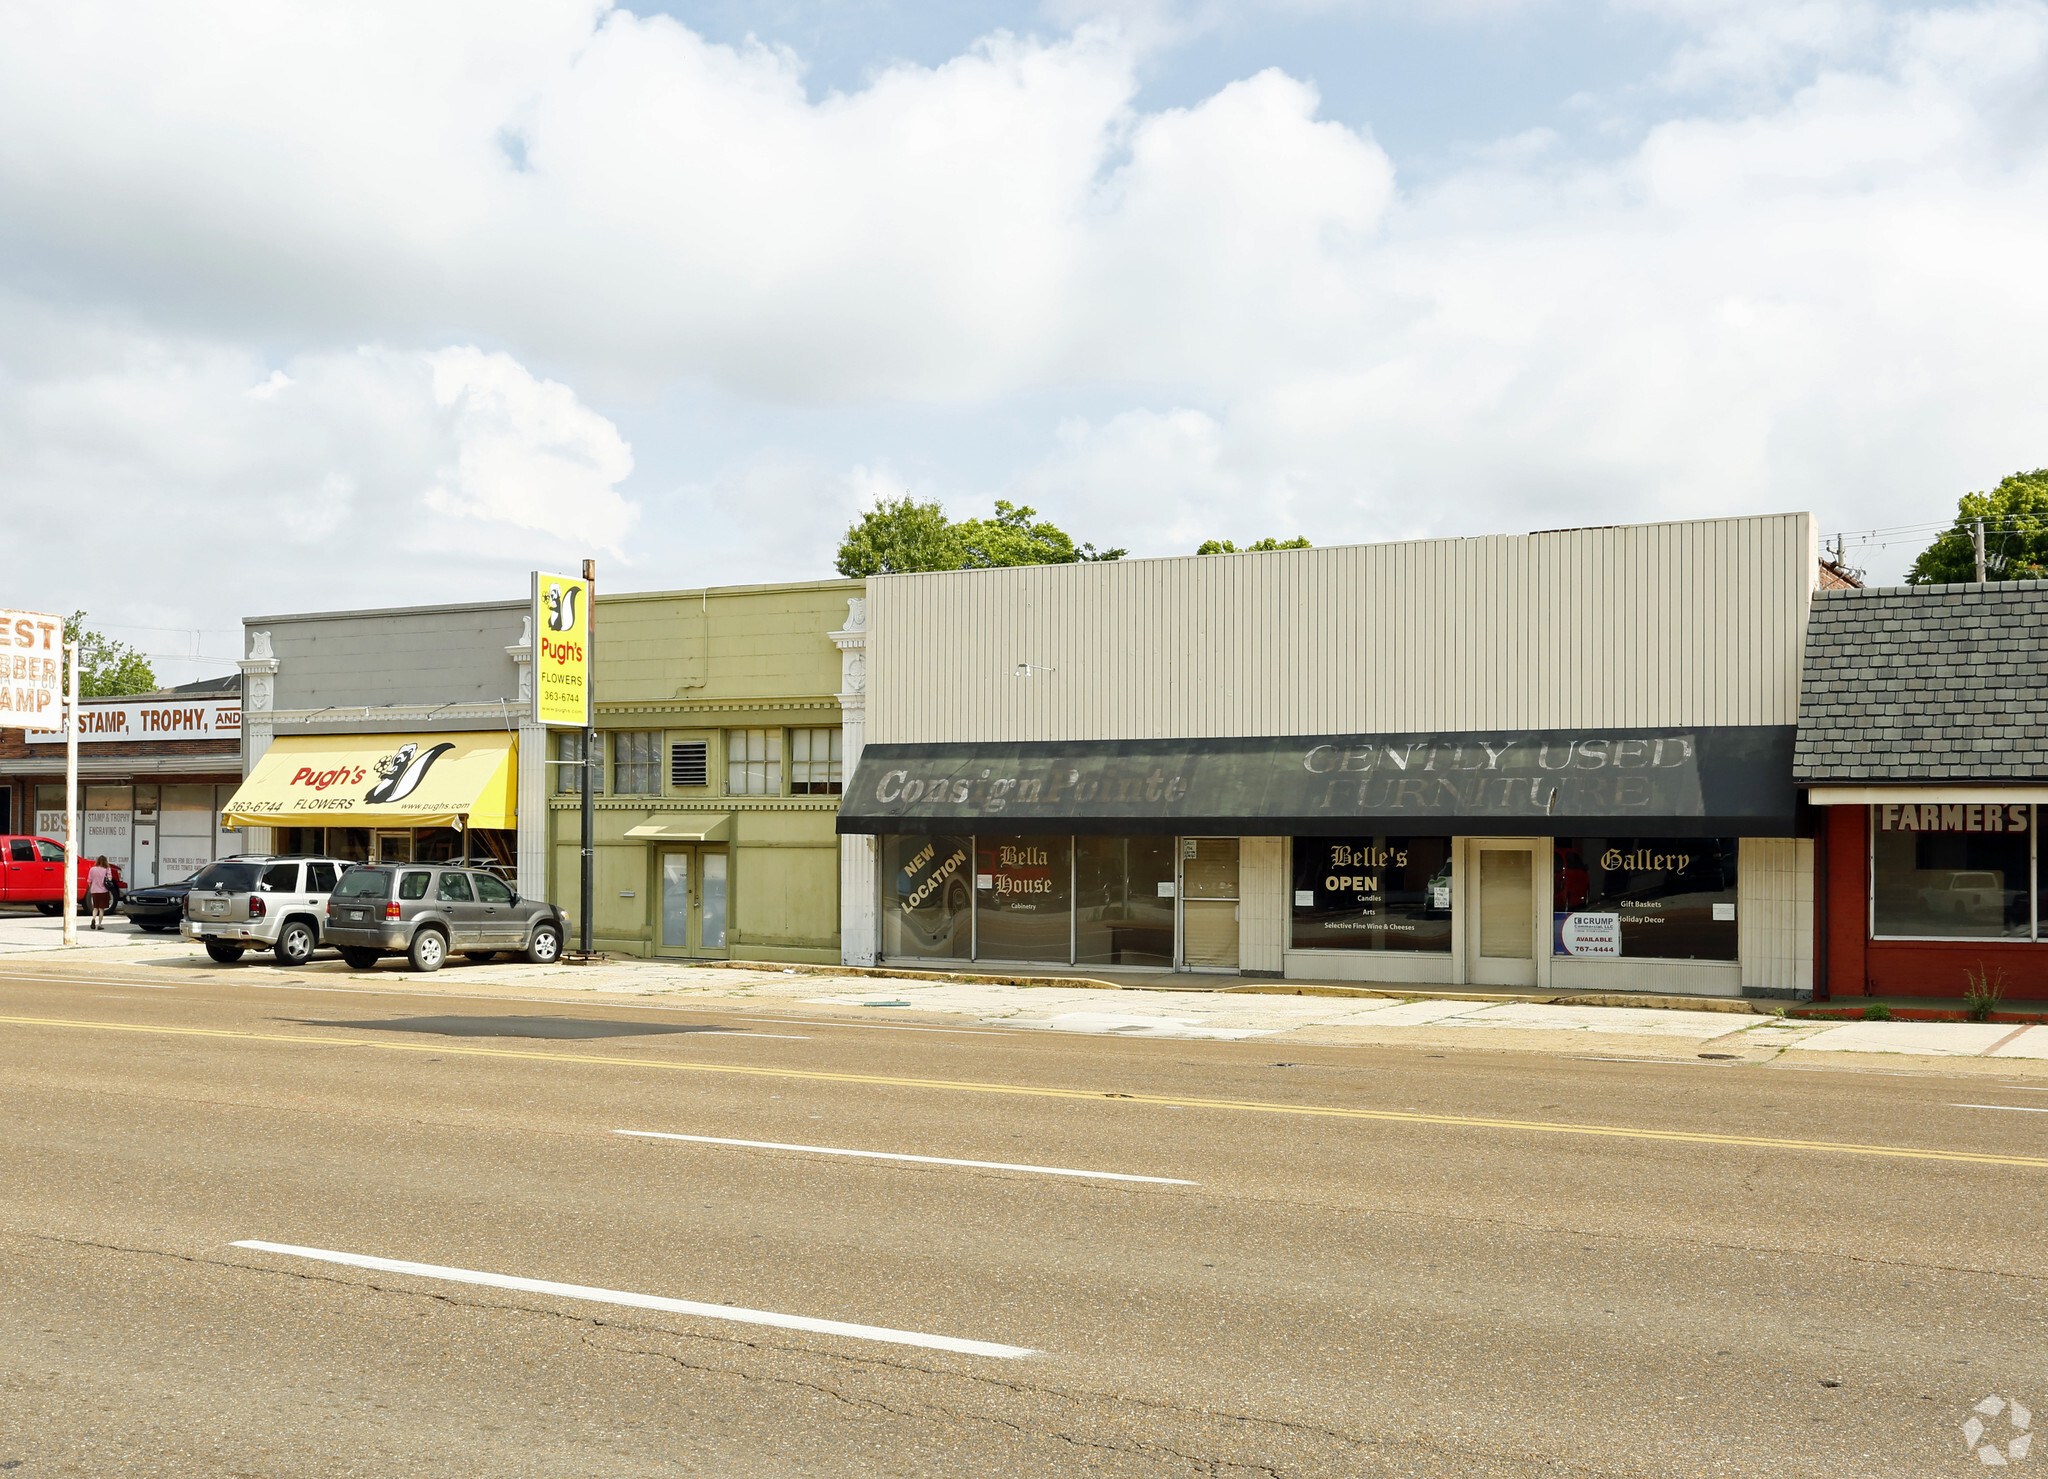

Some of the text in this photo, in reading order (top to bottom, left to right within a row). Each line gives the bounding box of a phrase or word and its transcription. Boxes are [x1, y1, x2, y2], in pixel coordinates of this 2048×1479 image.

[541, 637, 583, 665] Pugh's
[541, 671, 583, 687] FLOWERS
[544, 690, 580, 703] 363-6744
[141, 708, 209, 734] TROPHY,
[215, 712, 241, 725] AND
[1538, 738, 1692, 770] USED
[289, 765, 367, 791] Pugh's
[228, 801, 284, 812] 363-6744
[293, 798, 356, 810] FLOWERS
[400, 802, 471, 812] www.pughs.com
[904, 843, 935, 878] NEW
[1000, 845, 1048, 868] Bella
[1331, 845, 1408, 869] Belle's
[1600, 848, 1690, 875] Gallery
[901, 849, 967, 914] LOCATION
[995, 873, 1052, 896] House
[1325, 876, 1378, 891] OPEN
[1357, 894, 1382, 902] Candles
[1620, 900, 1662, 908] Gift Baskets
[1011, 902, 1036, 910] Cabinetry
[1362, 908, 1376, 916] Arts
[1324, 922, 1415, 931] Selective Fine Wine & Cheeses
[1583, 917, 1613, 925] CRUMP
[1644, 916, 1665, 924] Decor
